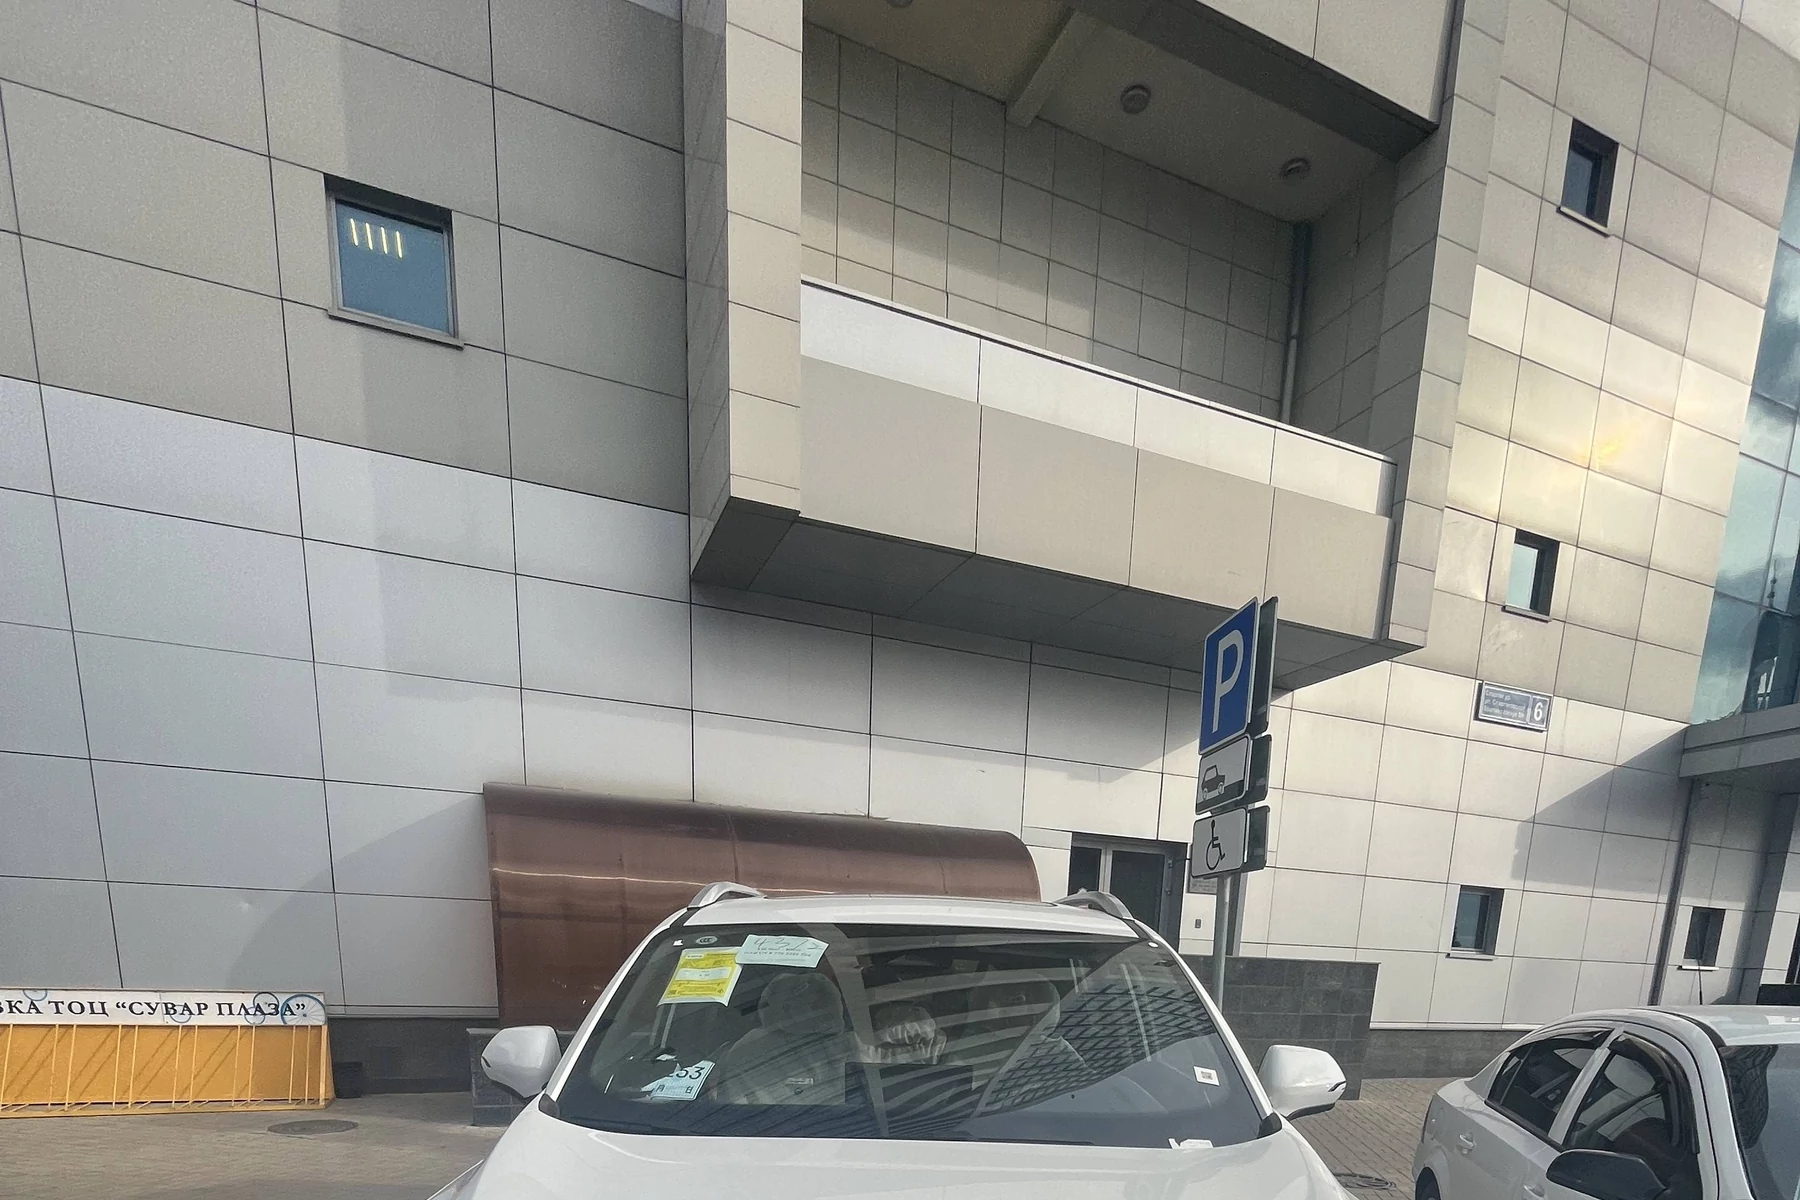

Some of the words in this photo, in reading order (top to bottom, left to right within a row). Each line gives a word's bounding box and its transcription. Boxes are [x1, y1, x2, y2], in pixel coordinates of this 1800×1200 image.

[1212, 629, 1244, 733] P
[1533, 701, 1543, 721] 6
[48, 1001, 110, 1018] ТОЦ
